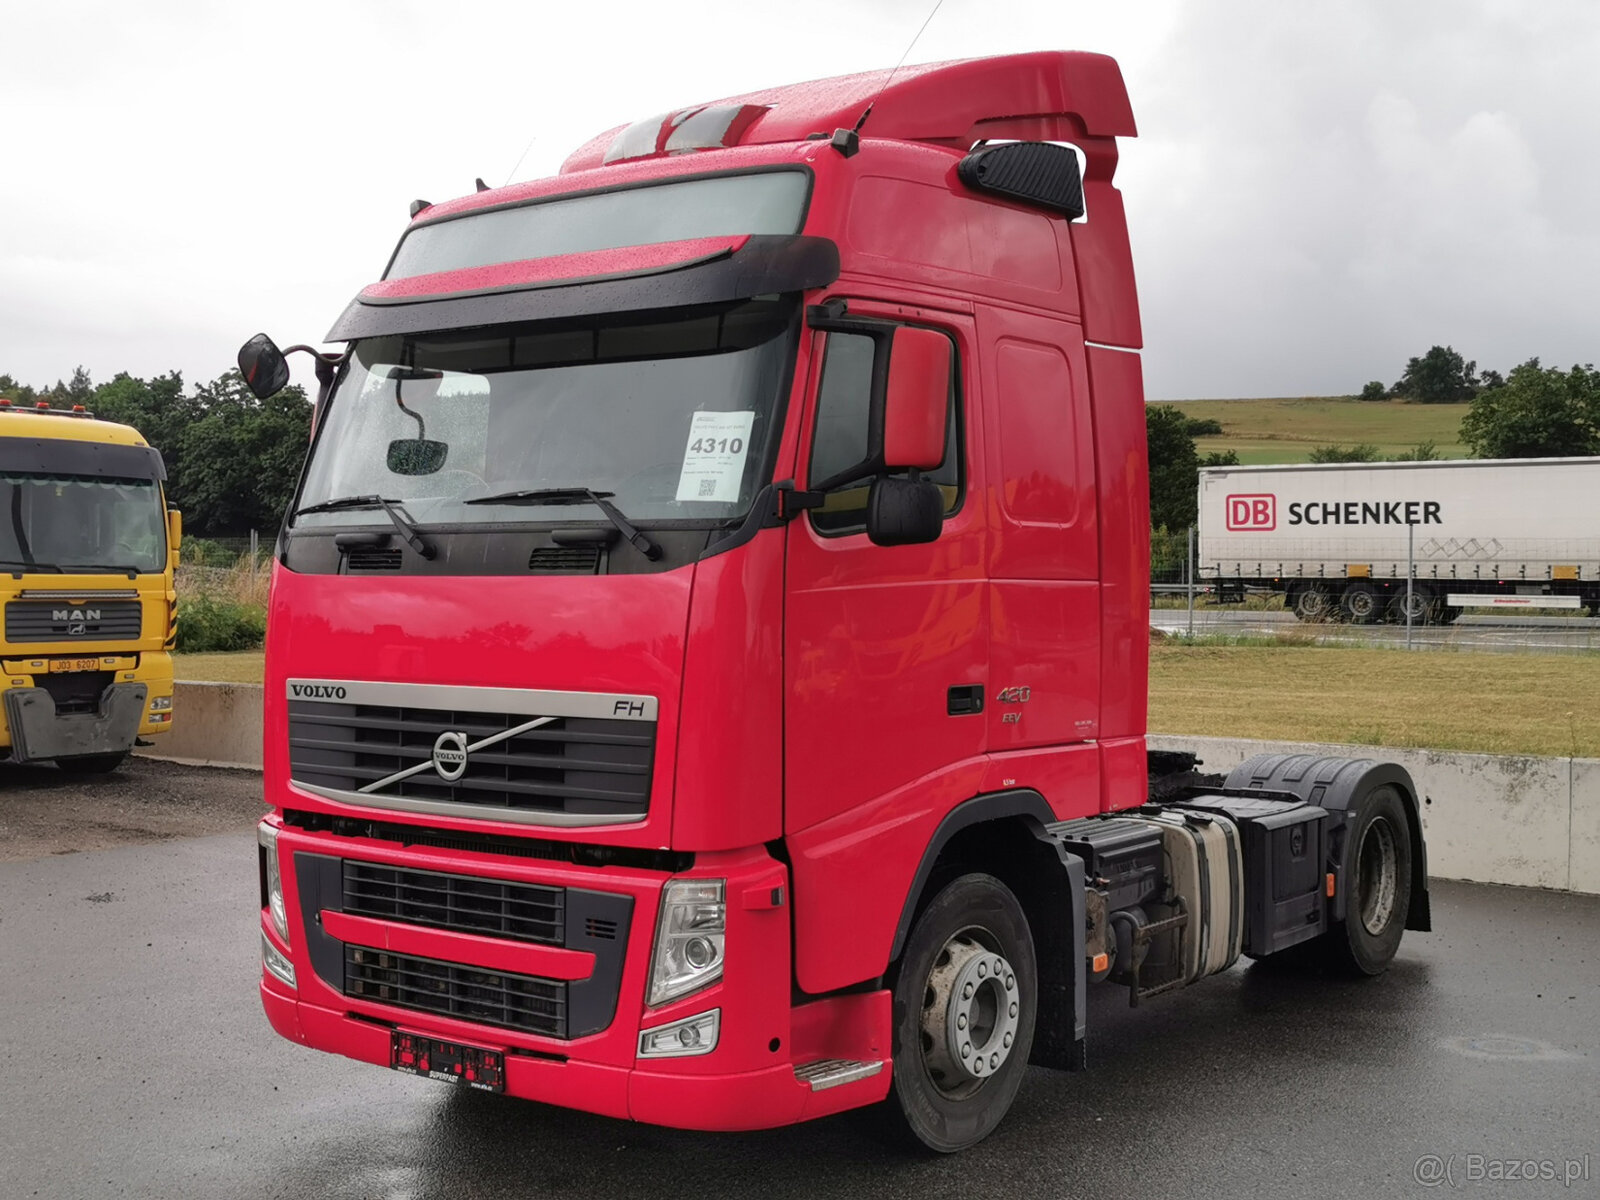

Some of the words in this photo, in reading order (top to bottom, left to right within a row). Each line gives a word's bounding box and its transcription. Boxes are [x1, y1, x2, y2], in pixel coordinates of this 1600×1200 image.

[690, 438, 743, 454] 4310
[1231, 500, 1271, 525] DB
[1288, 501, 1443, 525] SCHENKER
[52, 609, 101, 621] MAN
[76, 659, 96, 669] 6207
[291, 684, 347, 699] VOLVO
[996, 685, 1031, 703] 420
[613, 700, 645, 717] FH
[1002, 712, 1022, 723] EEV
[435, 751, 465, 761] VOLVO
[429, 1070, 459, 1083] SUPERFAST
